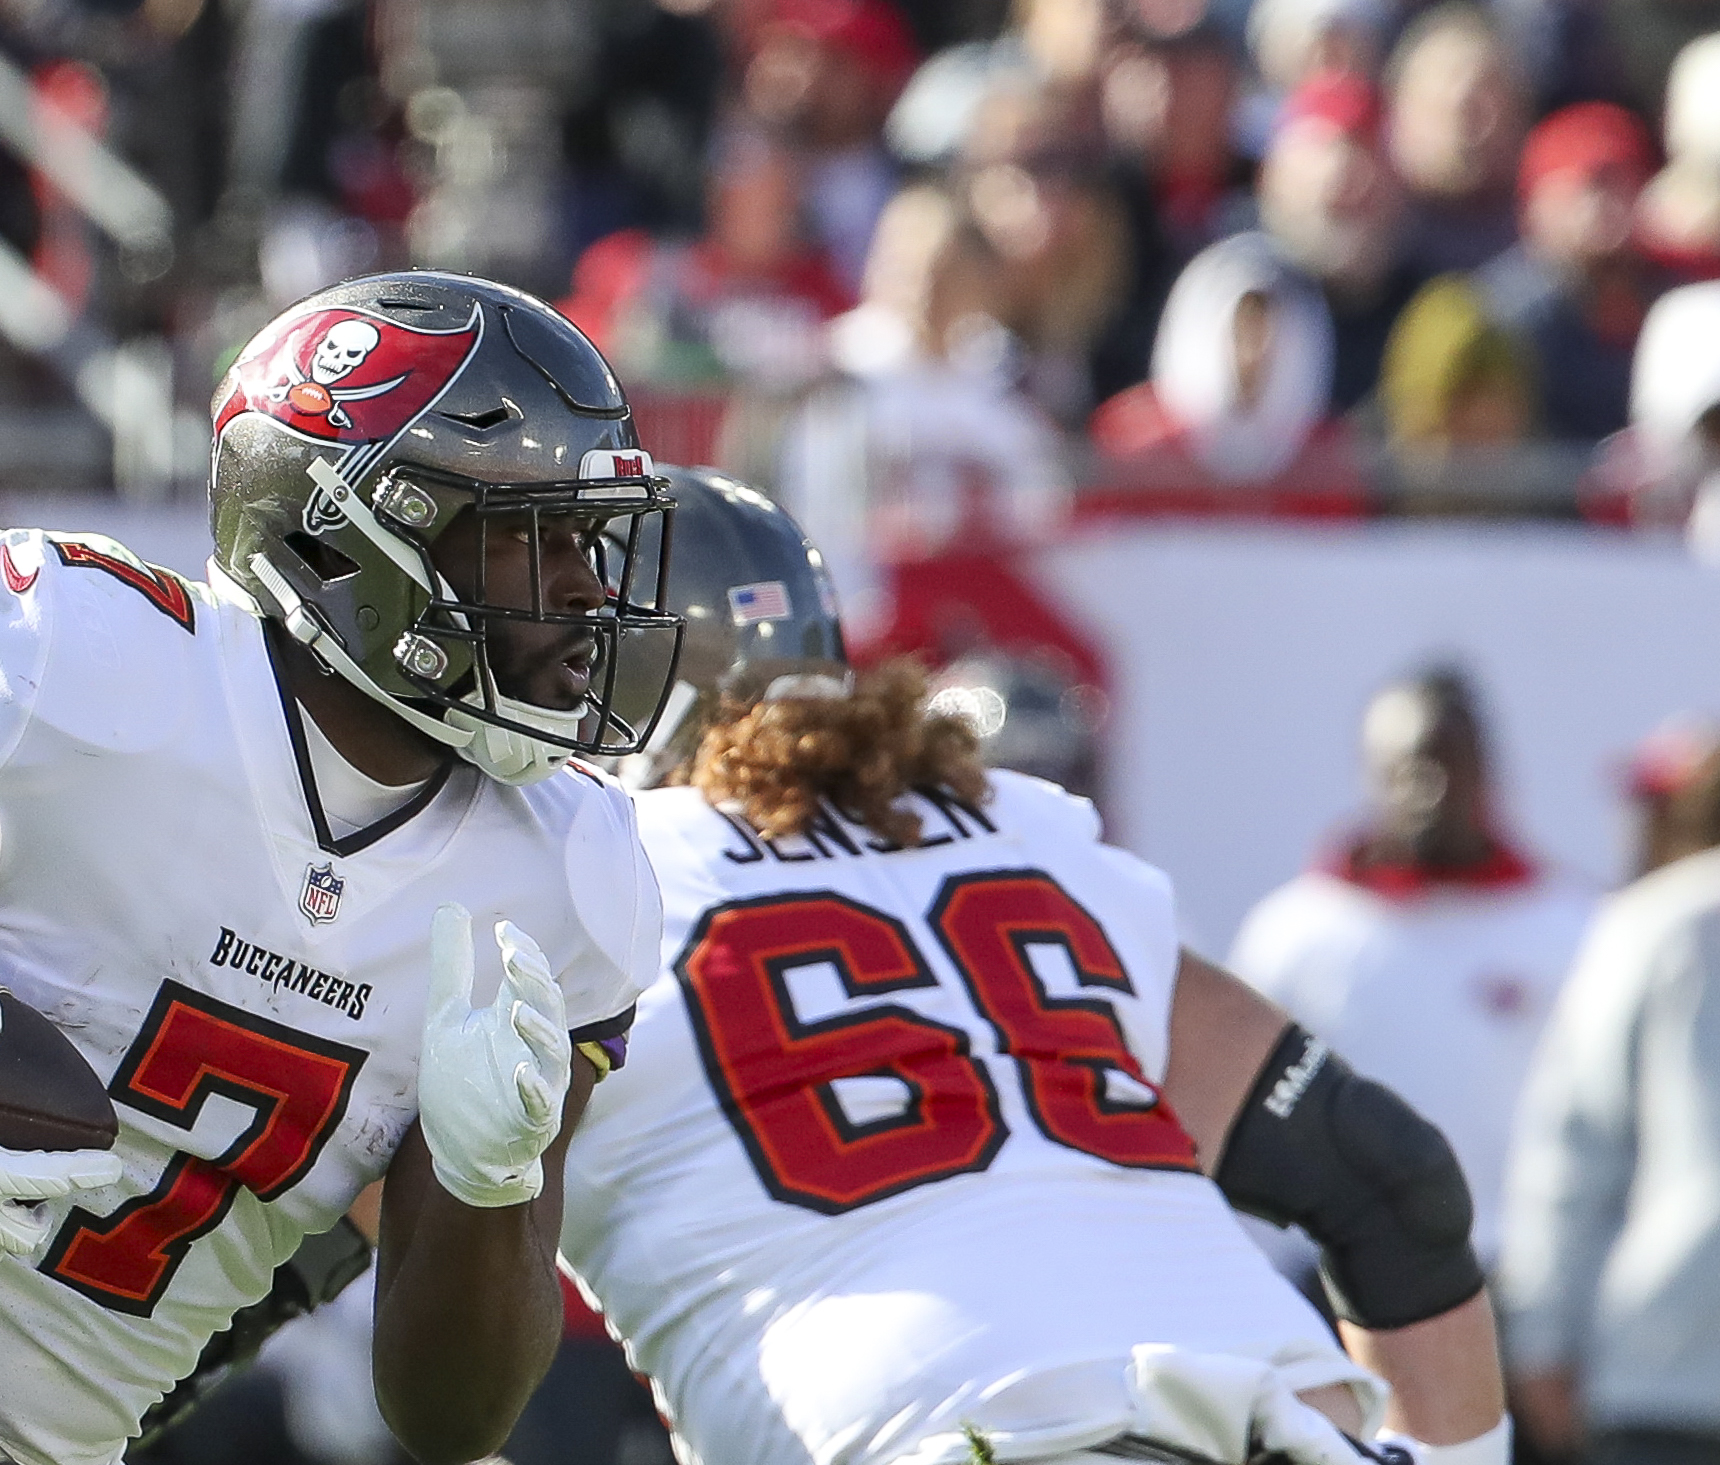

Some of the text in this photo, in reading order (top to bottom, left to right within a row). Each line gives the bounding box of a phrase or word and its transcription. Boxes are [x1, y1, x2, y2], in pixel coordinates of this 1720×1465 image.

[209, 925, 375, 1021] BUCCANEERS
[306, 886, 335, 916] NFL
[34, 977, 371, 1320] 7
[671, 867, 1200, 1216] 66
